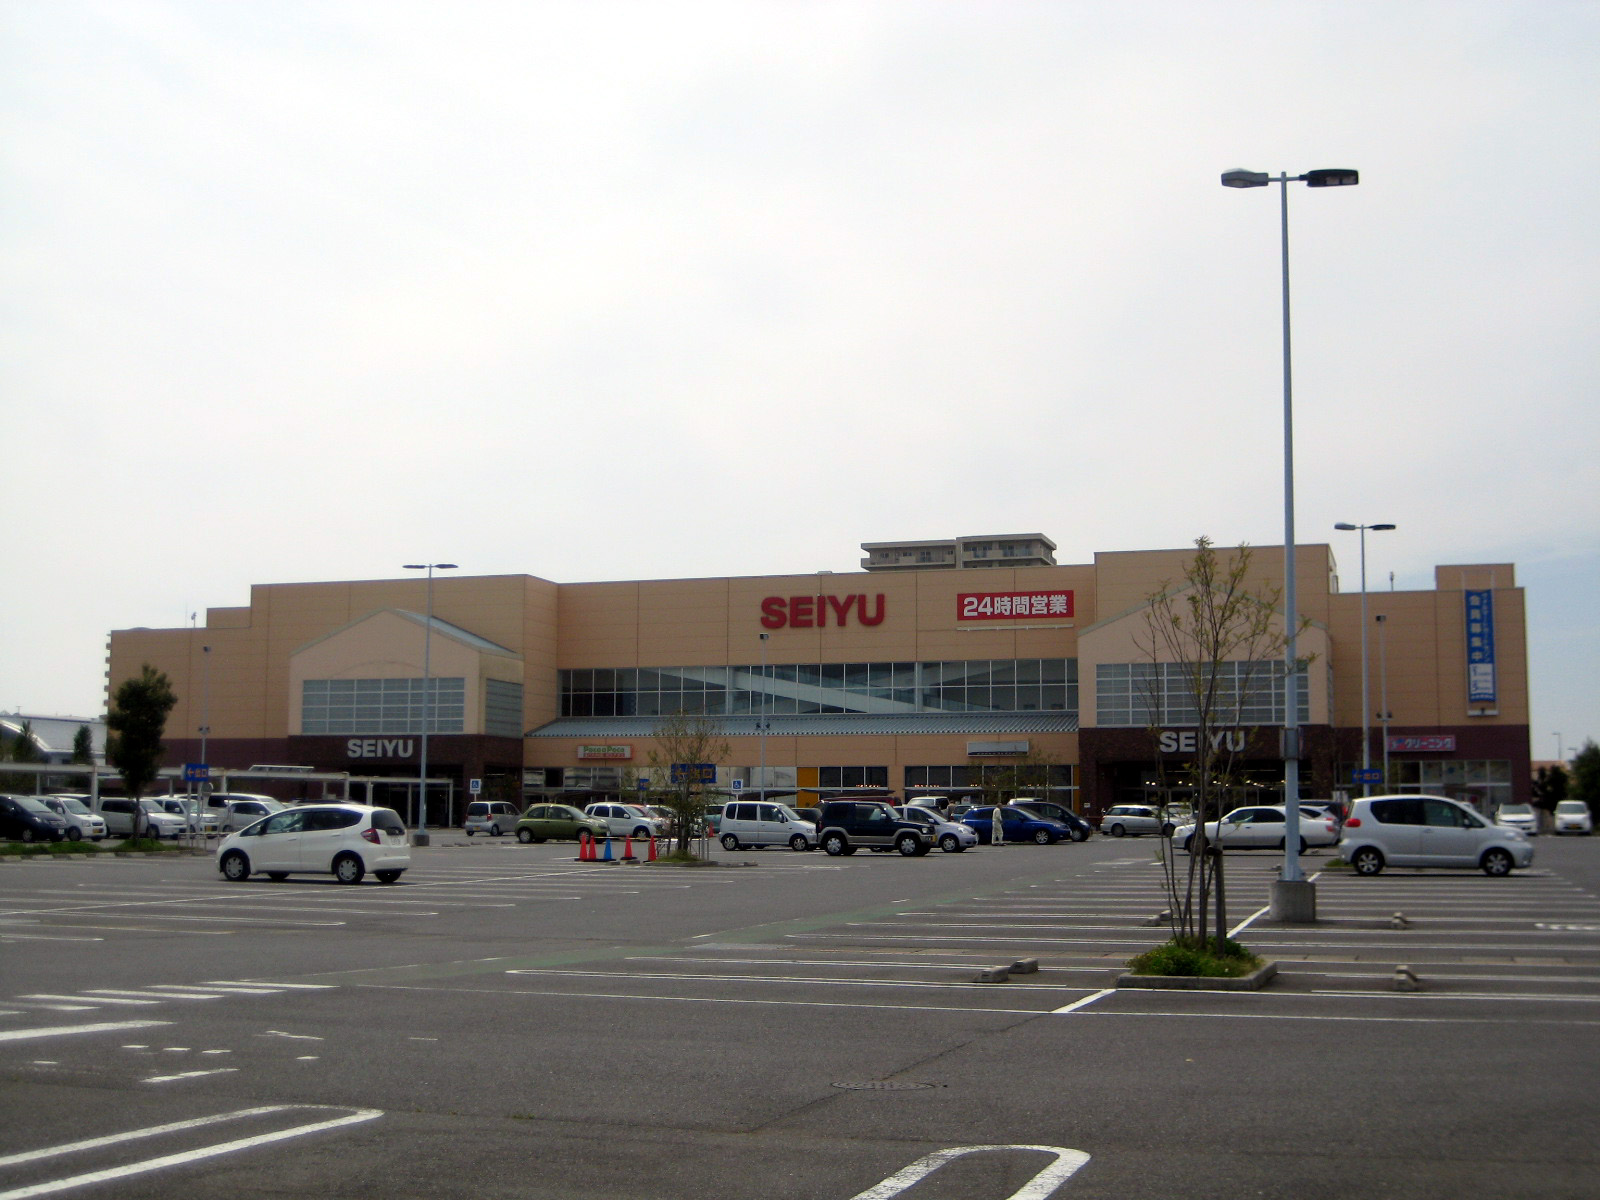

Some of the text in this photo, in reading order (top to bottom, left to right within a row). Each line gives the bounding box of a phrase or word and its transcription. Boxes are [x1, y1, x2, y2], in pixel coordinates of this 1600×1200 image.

[760, 594, 885, 629] SEIYU
[963, 594, 1067, 617] 24時間営業
[347, 739, 414, 758] SEIYU
[1159, 731, 1245, 753] SEYU
